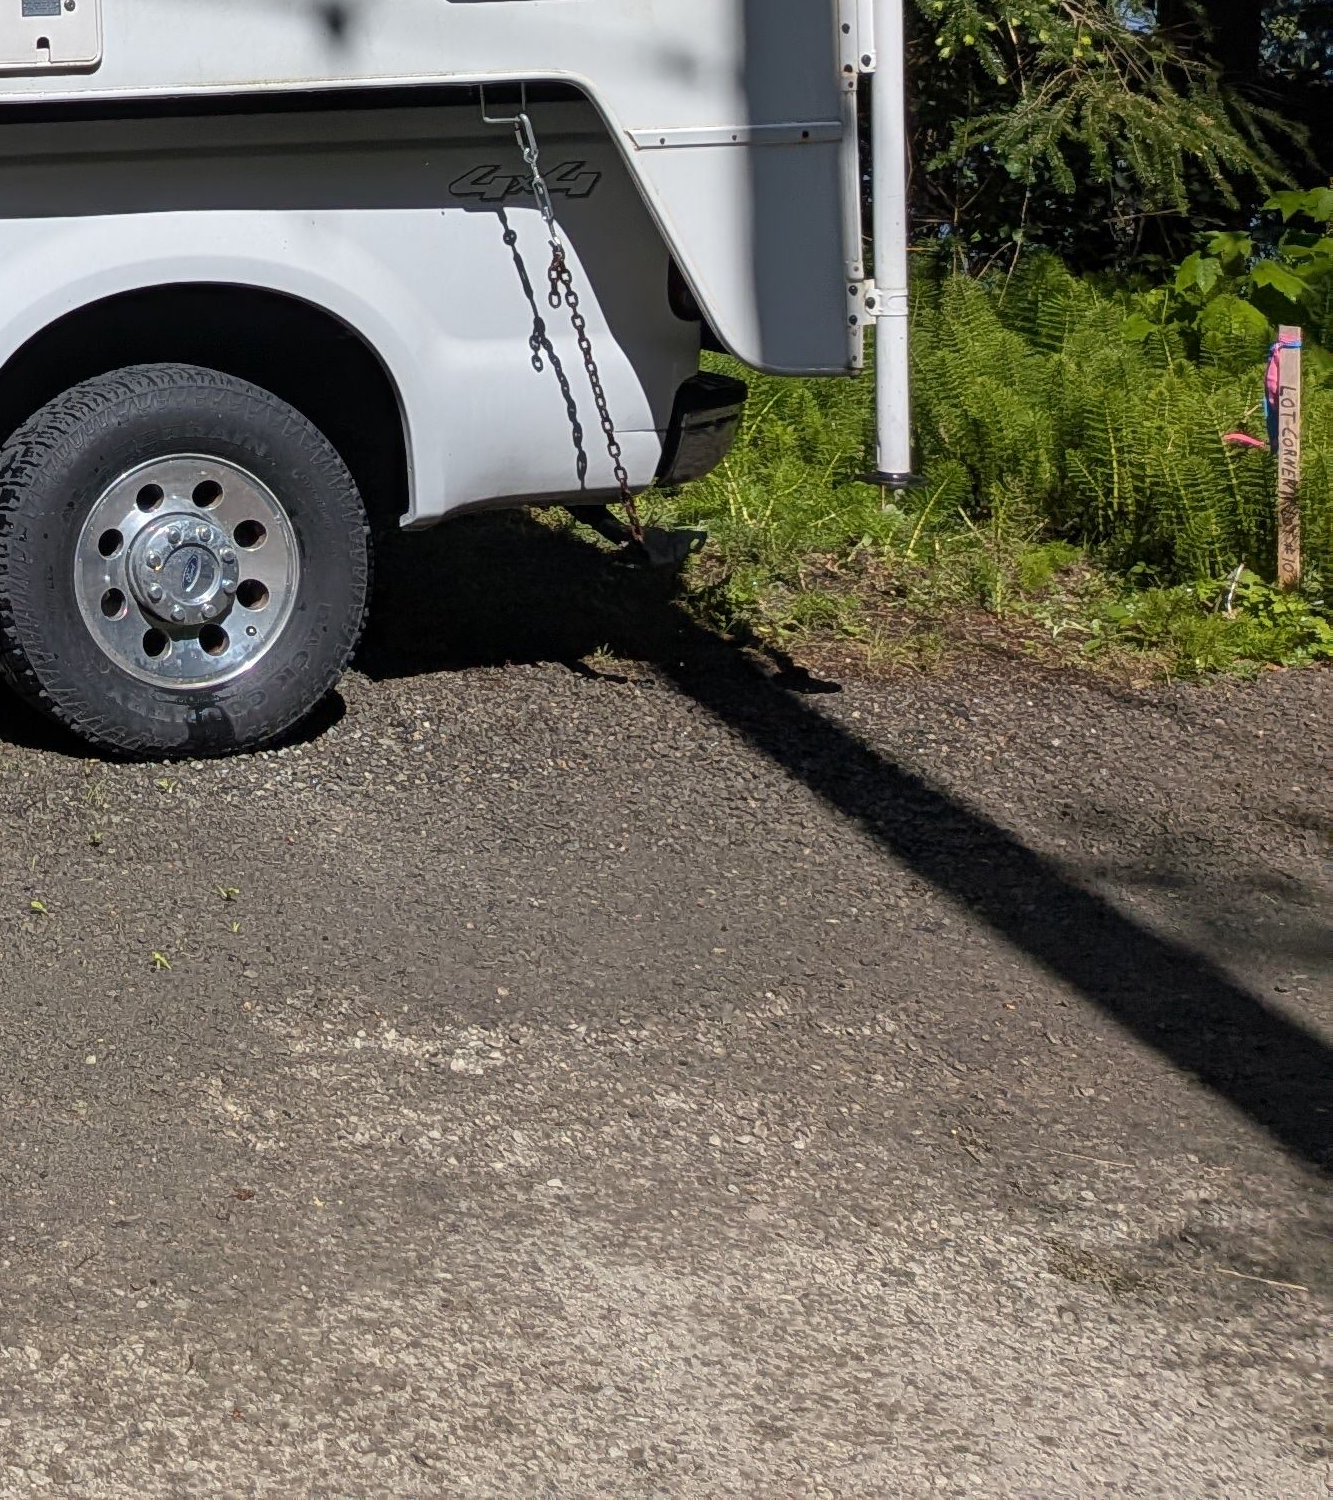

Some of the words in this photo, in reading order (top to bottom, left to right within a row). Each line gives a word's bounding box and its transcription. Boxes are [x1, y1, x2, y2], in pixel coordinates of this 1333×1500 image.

[448, 161, 603, 201] 4x4
[1279, 385, 1297, 424] LOT
[1281, 427, 1299, 490] CORNER
